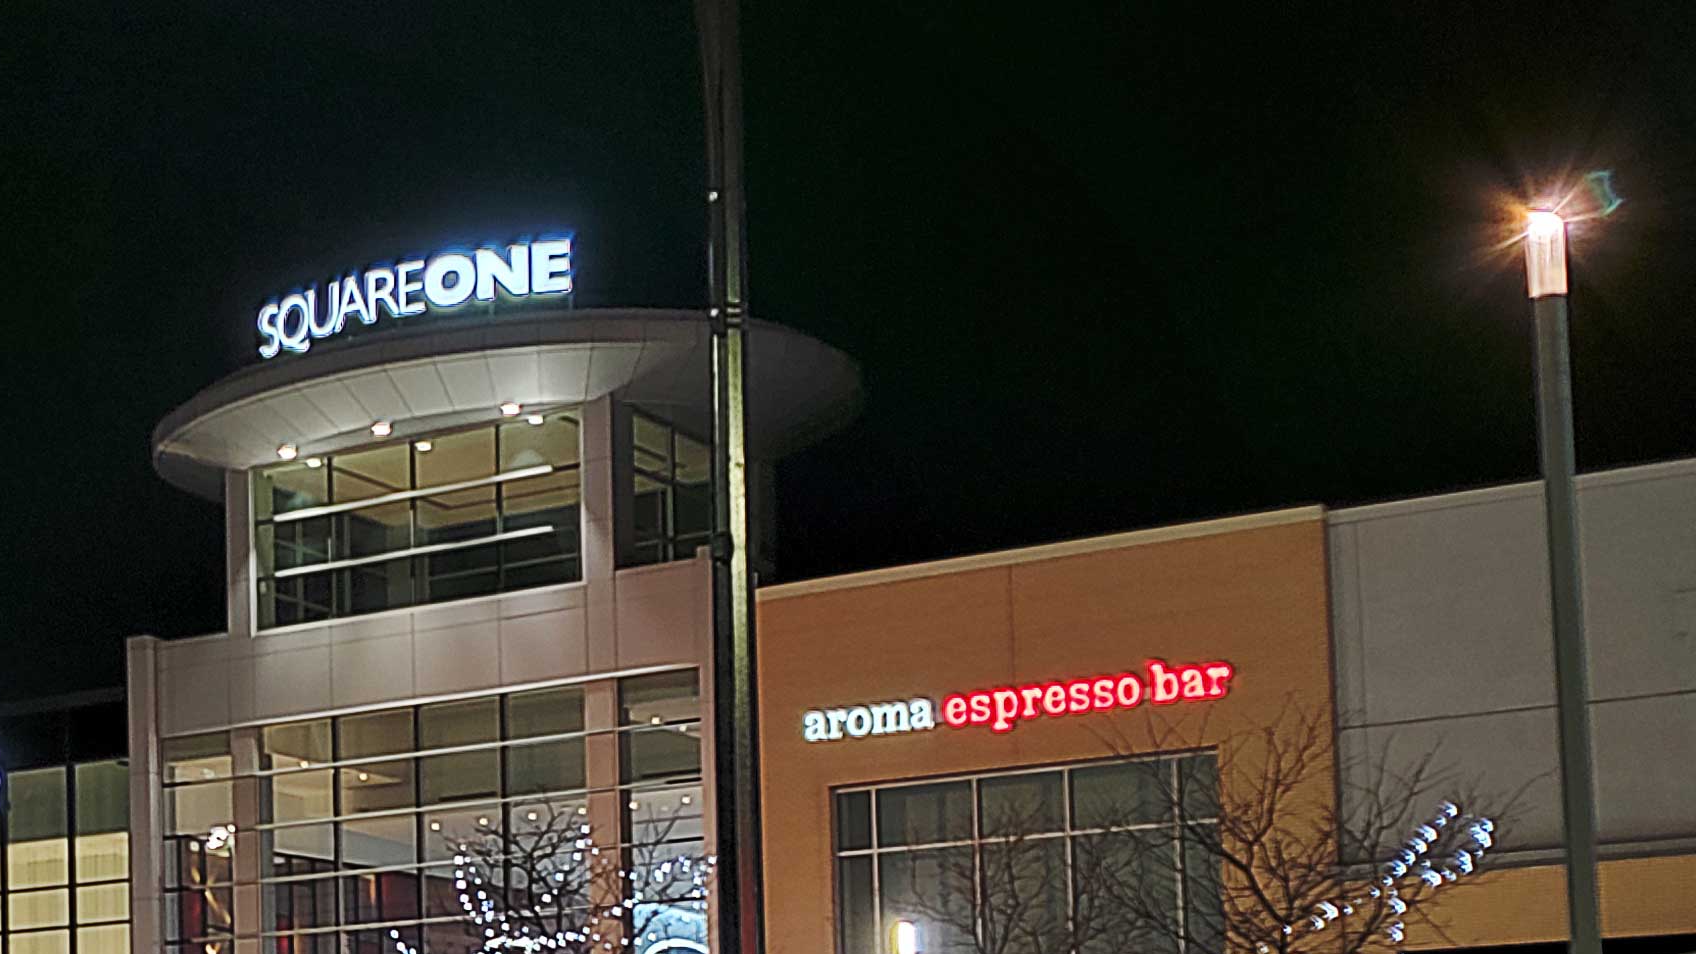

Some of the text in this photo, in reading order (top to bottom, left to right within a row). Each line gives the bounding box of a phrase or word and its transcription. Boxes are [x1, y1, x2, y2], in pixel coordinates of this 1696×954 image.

[803, 659, 1232, 742] aroma espresso bar
